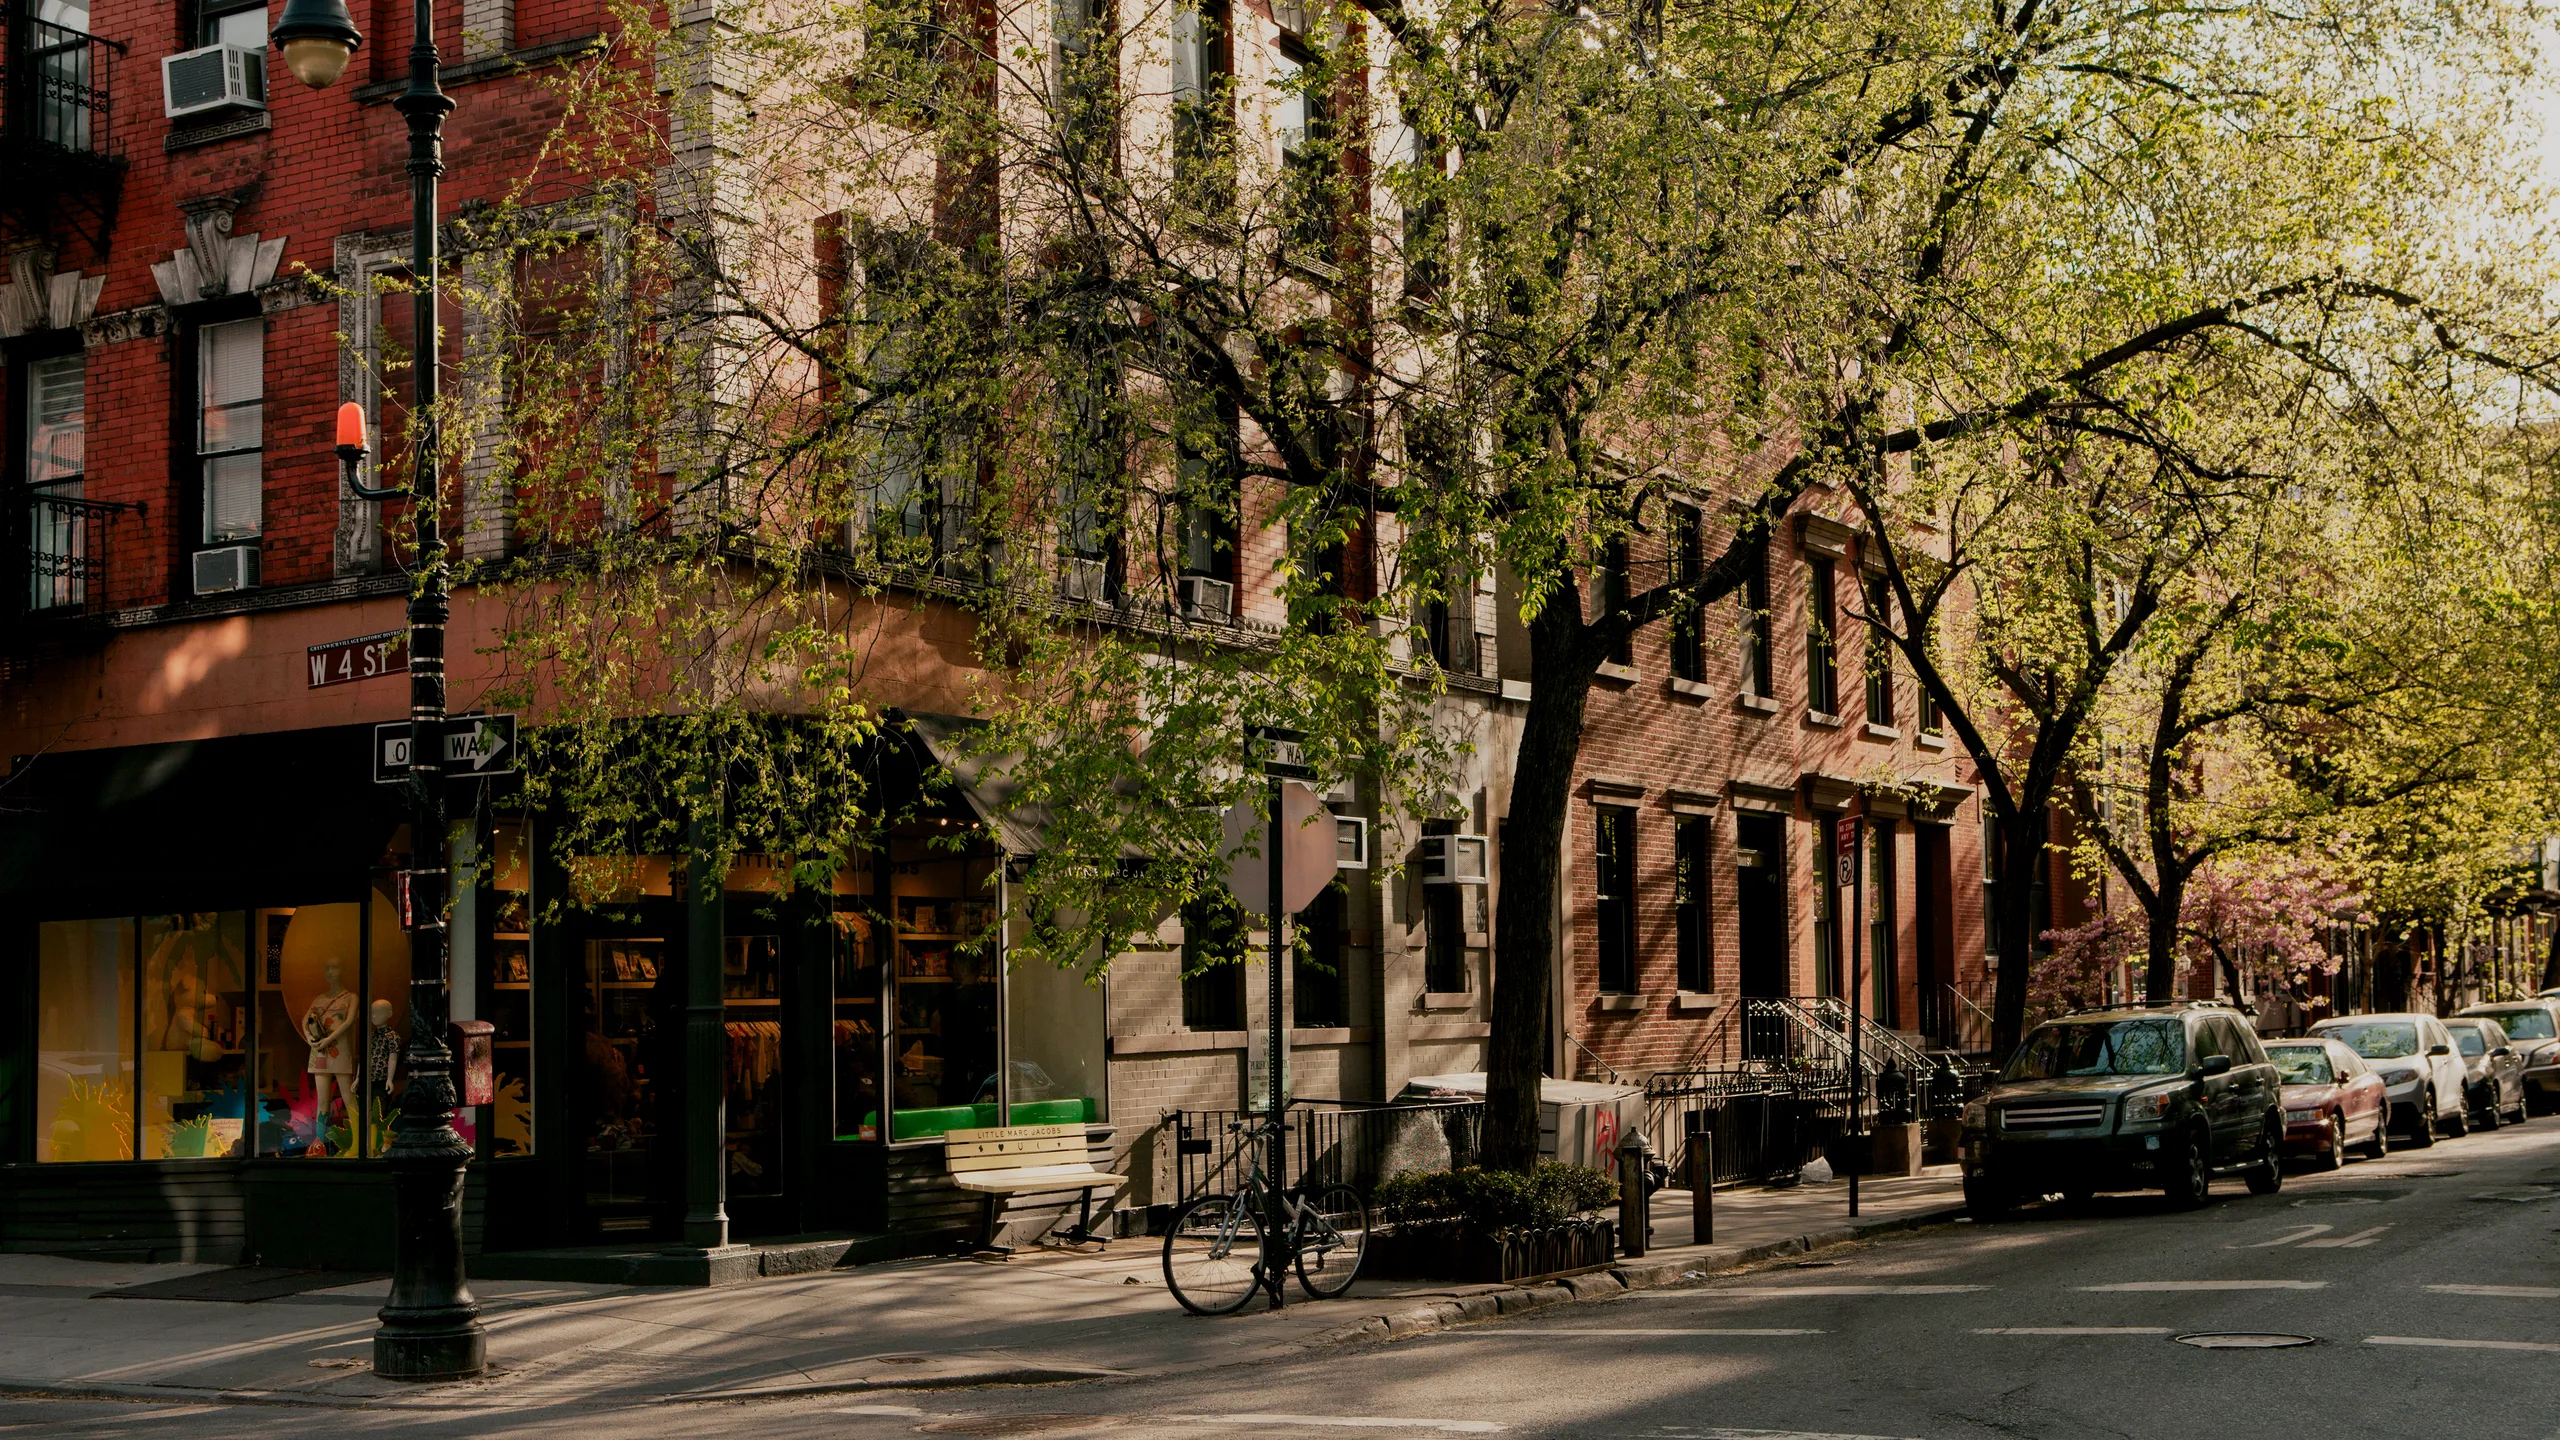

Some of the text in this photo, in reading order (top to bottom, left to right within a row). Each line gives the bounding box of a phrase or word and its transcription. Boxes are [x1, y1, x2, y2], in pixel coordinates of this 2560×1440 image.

[309, 628, 406, 652] GREENWICH VILLAGE HISTORIC DISTRICT
[310, 642, 389, 686] W 4 ST
[451, 734, 489, 759] WA
[977, 1127, 1062, 1140] LITTLE MARC JACOBS
